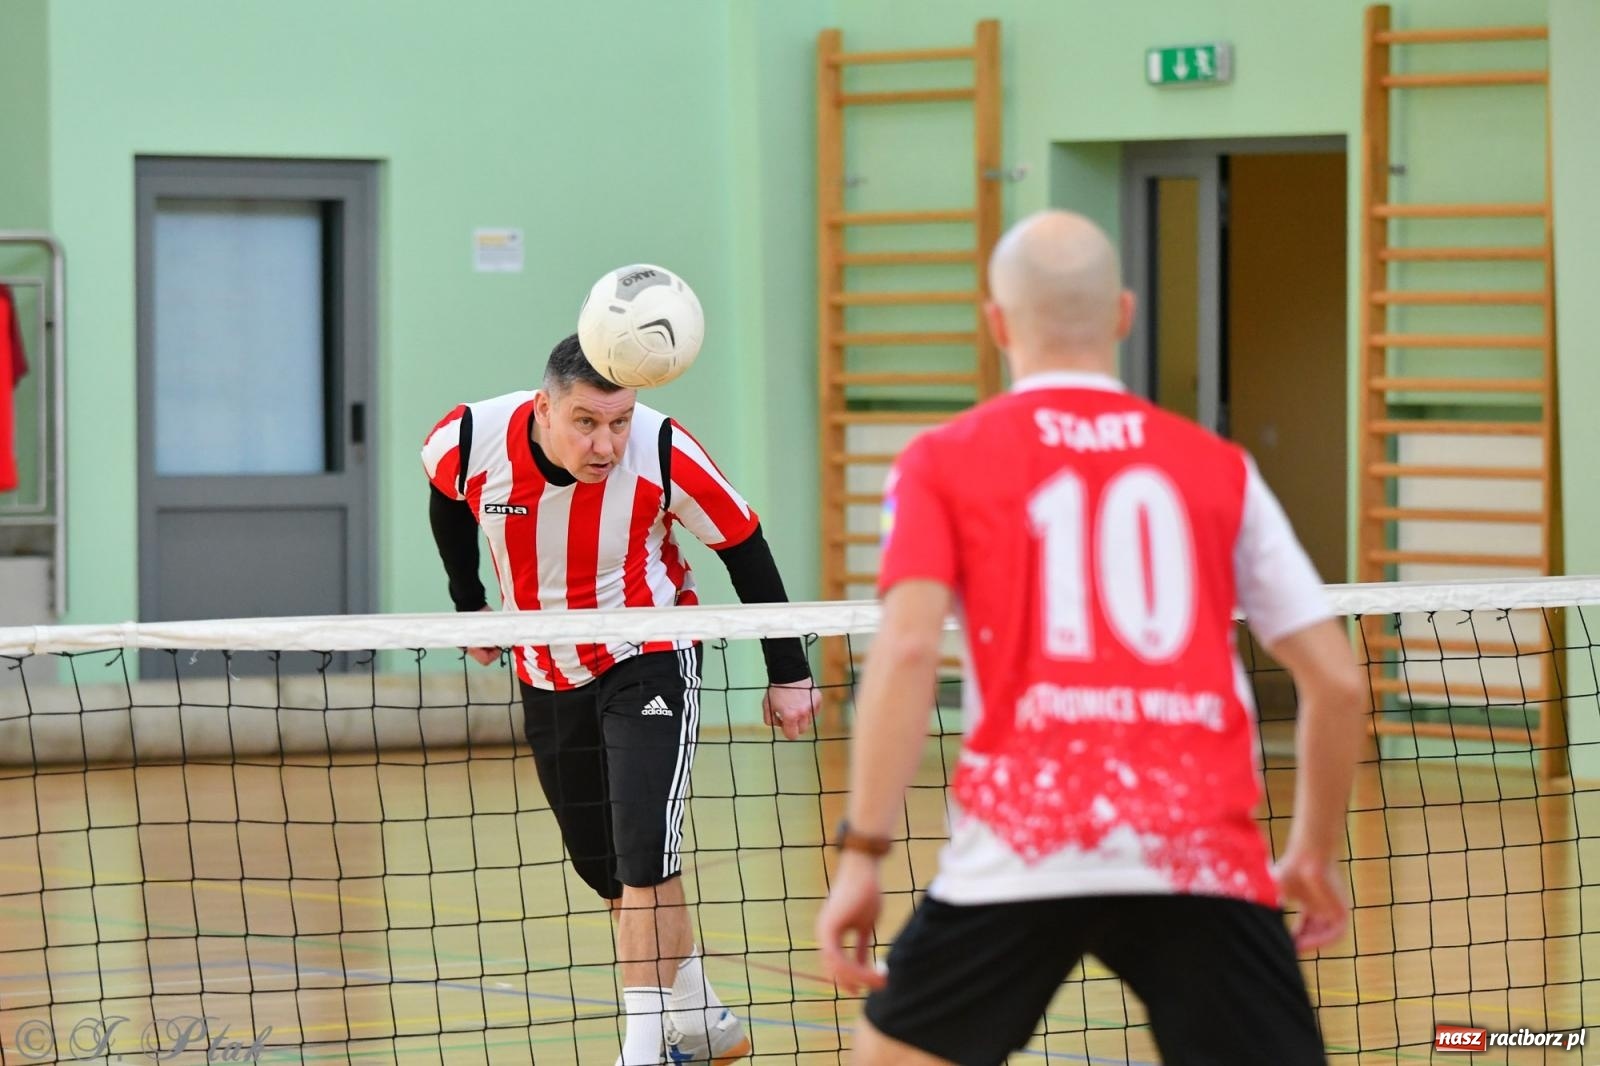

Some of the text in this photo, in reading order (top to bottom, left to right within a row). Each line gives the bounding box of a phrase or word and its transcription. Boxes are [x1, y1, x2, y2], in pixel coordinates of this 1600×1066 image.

[622, 270, 656, 287] JAKO
[1034, 408, 1144, 451] START
[1027, 467, 1195, 662] 10
[641, 708, 673, 717] adidas
